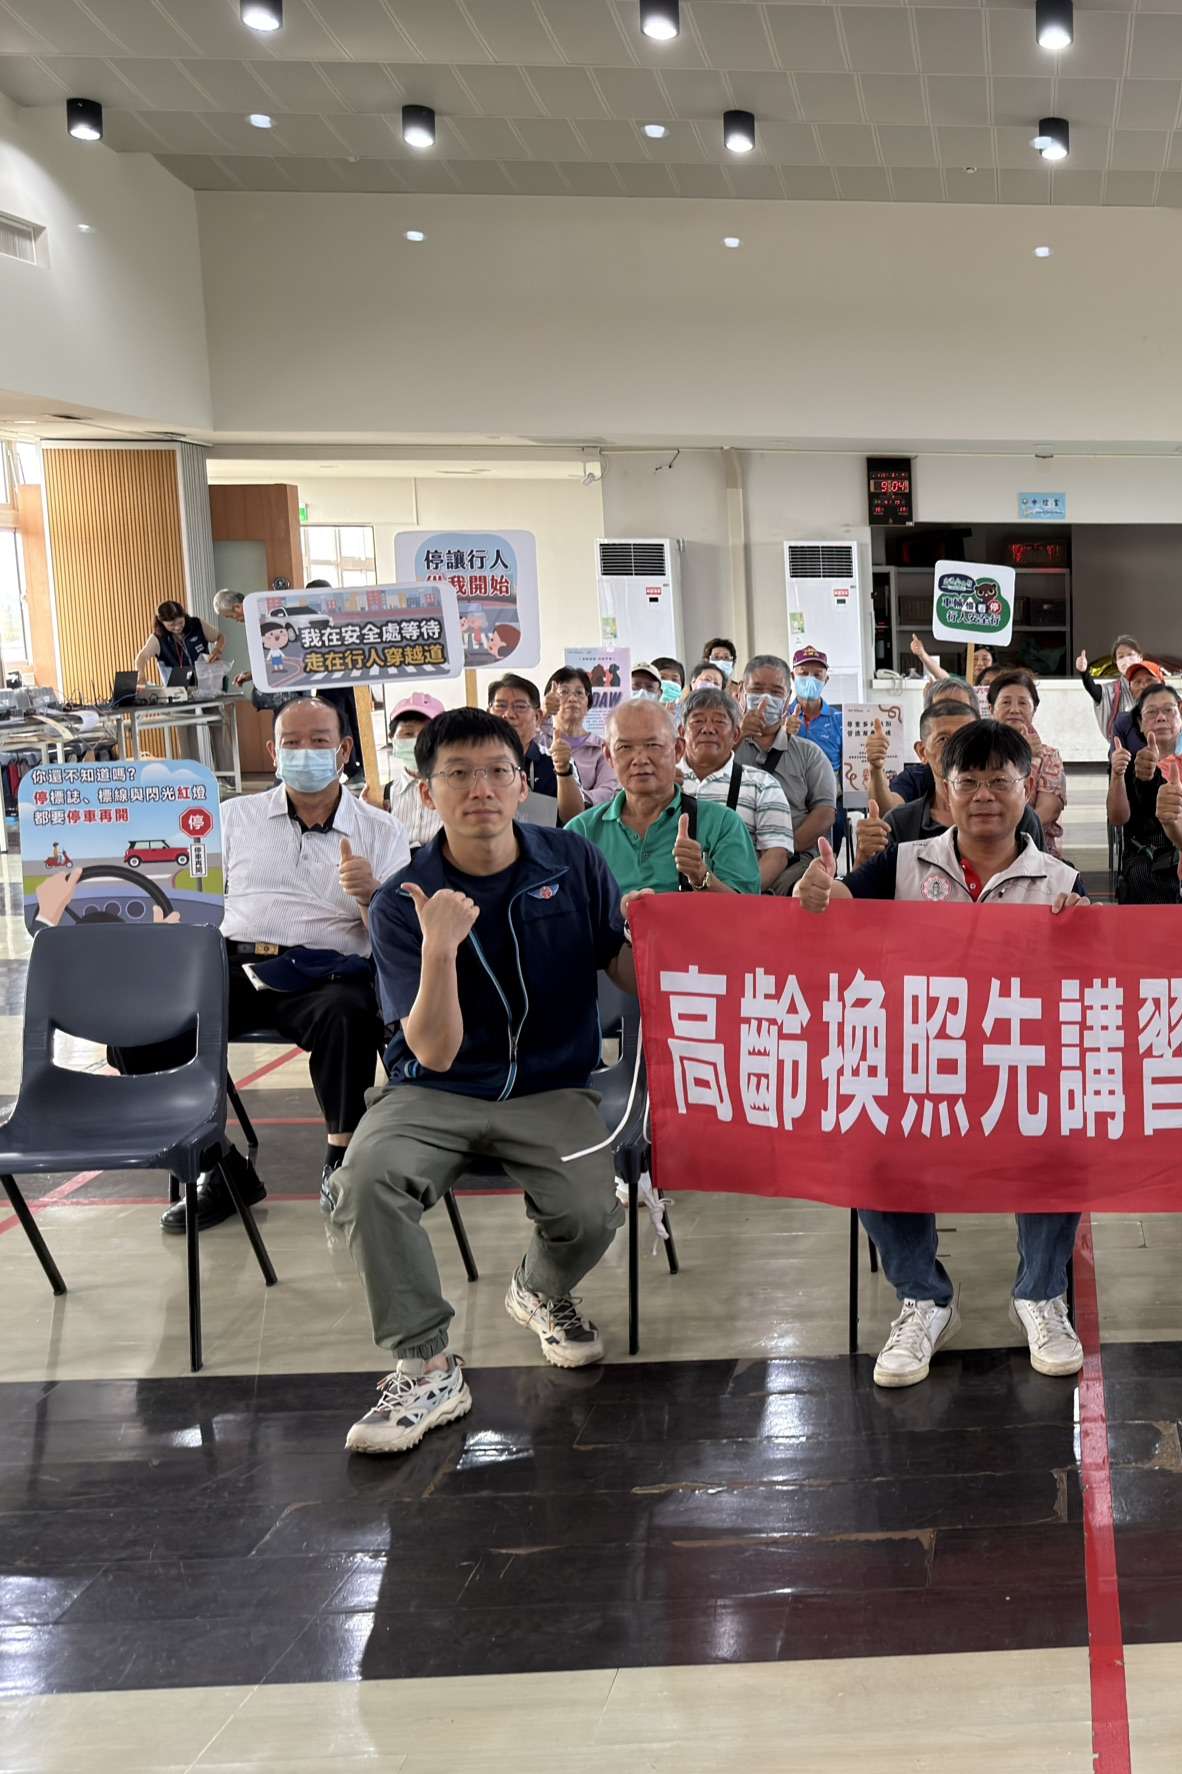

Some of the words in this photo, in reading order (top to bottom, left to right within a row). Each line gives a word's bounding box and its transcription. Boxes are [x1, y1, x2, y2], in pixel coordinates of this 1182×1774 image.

[424, 549, 508, 570] 停讓行人
[427, 575, 510, 595] 我開始
[301, 619, 442, 648] 我在安全處等待
[304, 644, 445, 673] 走在行人穿越道
[591, 691, 622, 708] DAW
[32, 767, 136, 784] 你還不知道嗎？
[34, 808, 129, 826] 都要停車再開
[188, 814, 204, 831] 停
